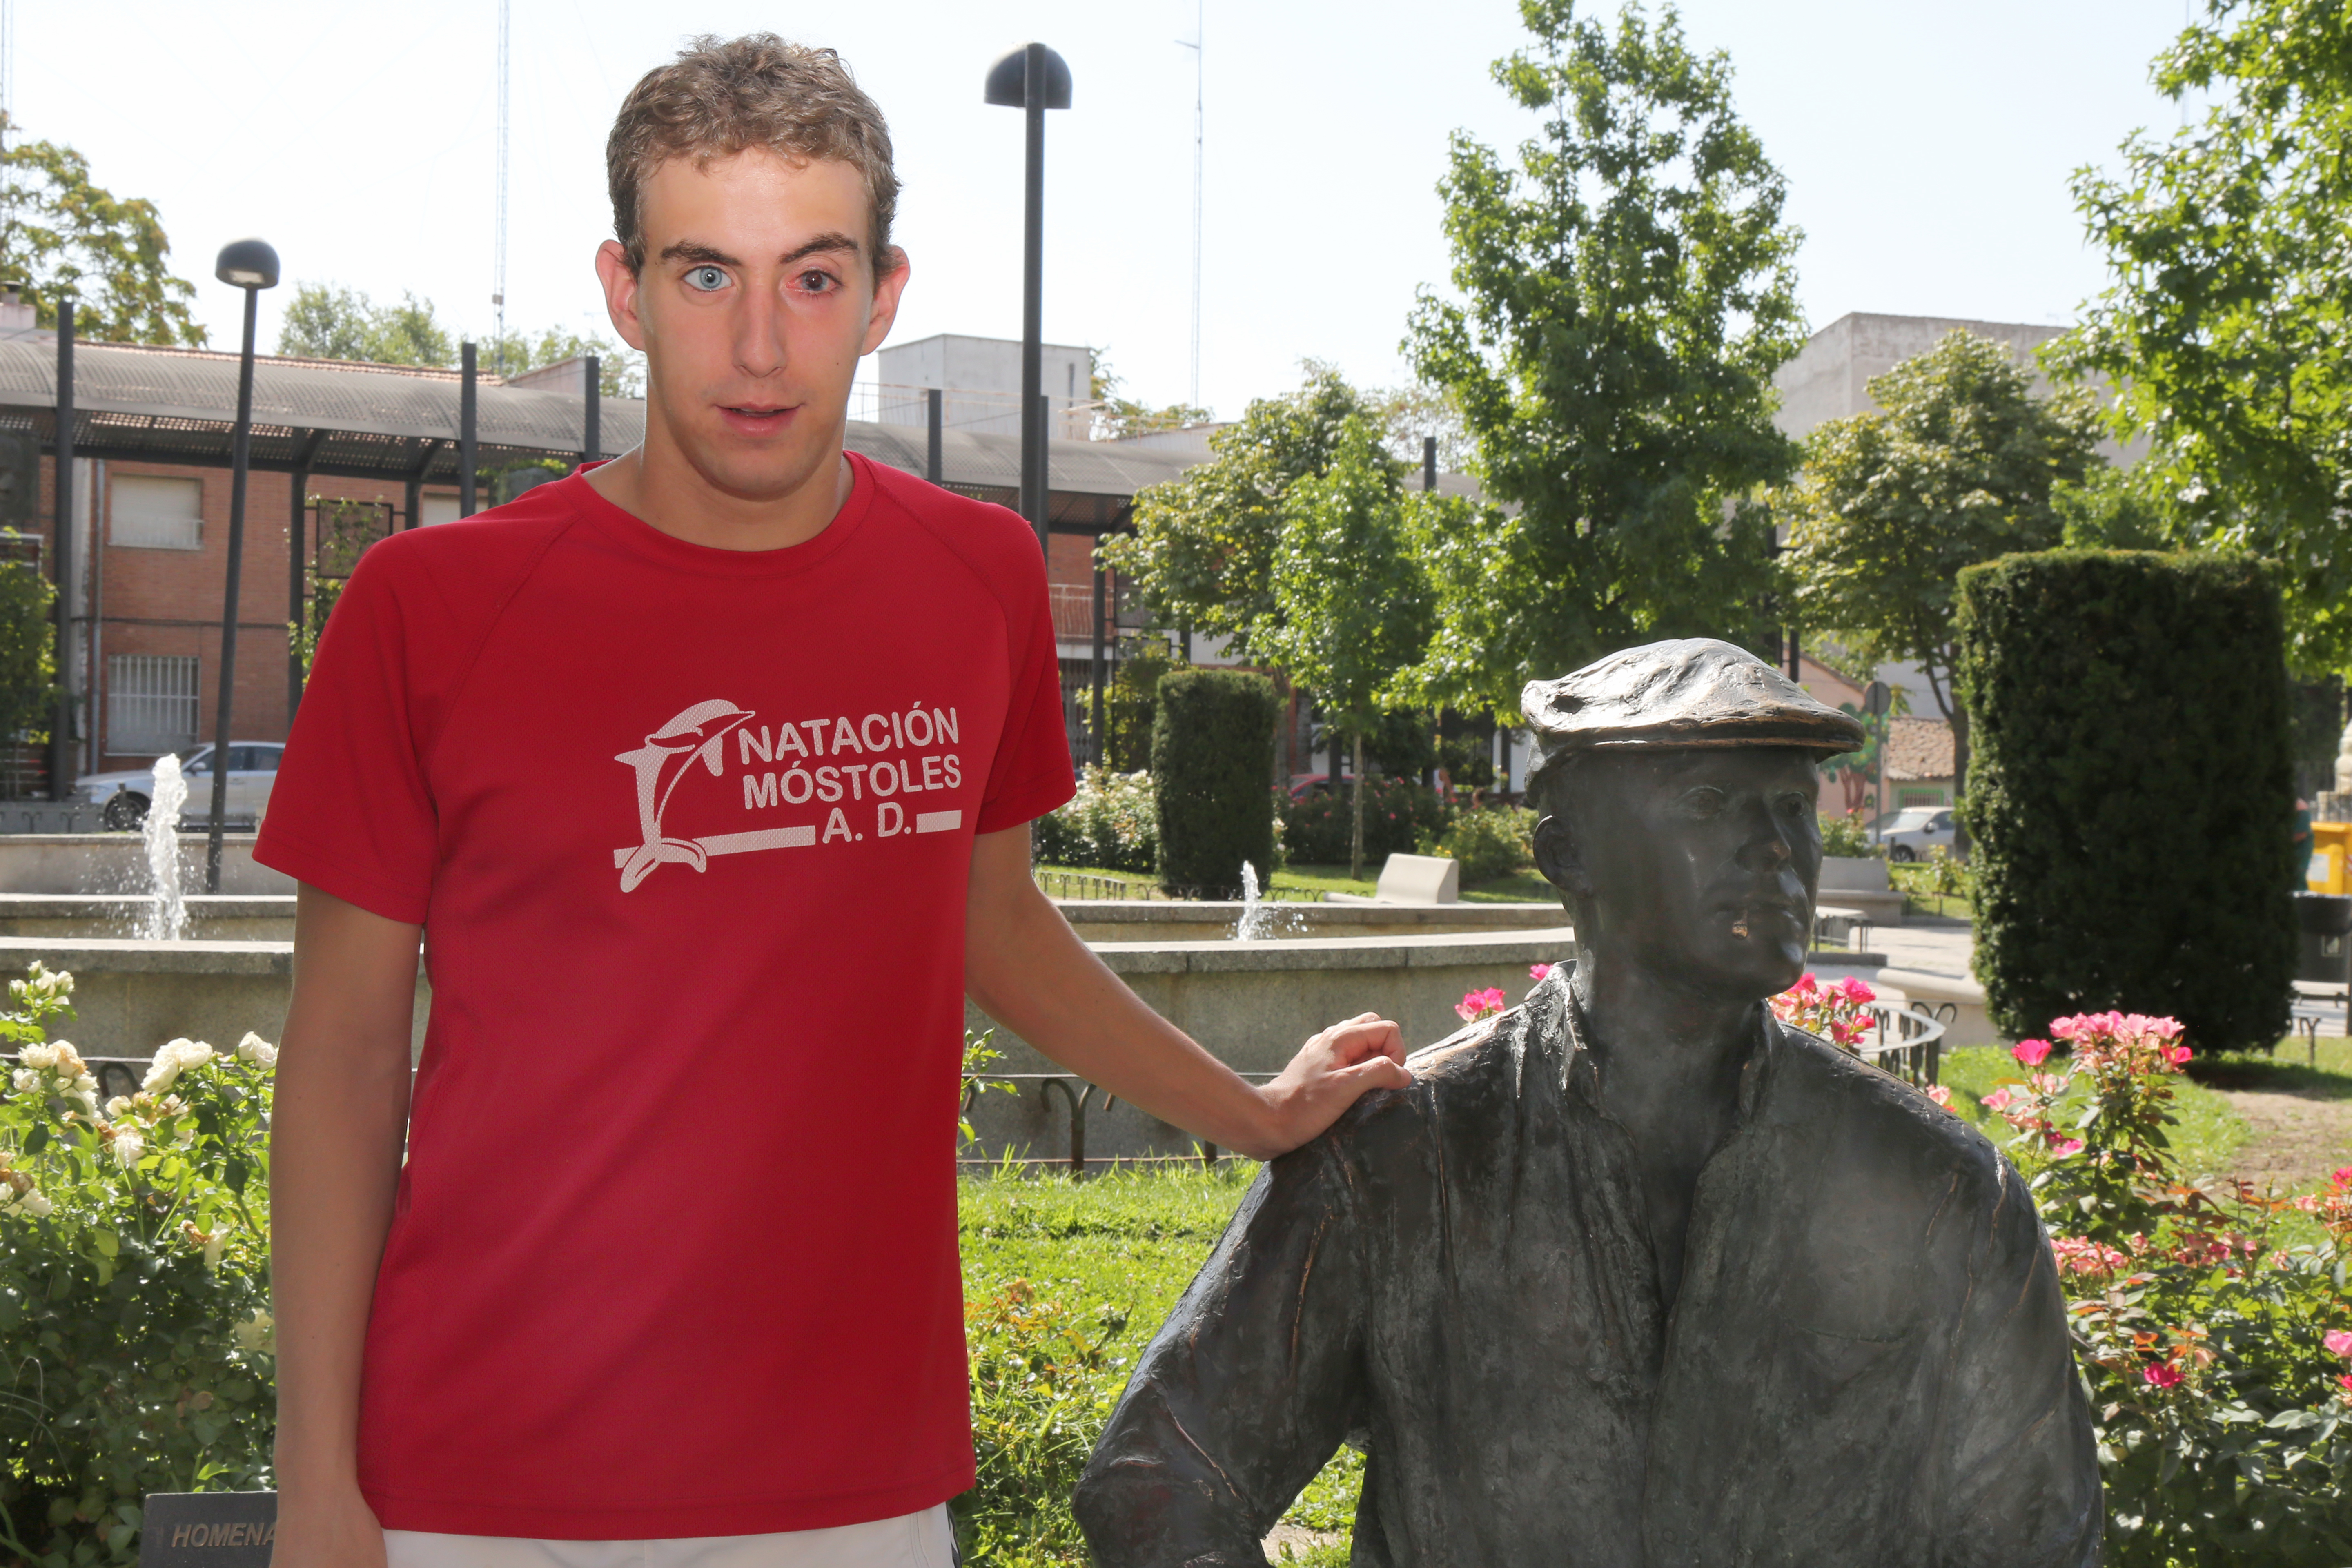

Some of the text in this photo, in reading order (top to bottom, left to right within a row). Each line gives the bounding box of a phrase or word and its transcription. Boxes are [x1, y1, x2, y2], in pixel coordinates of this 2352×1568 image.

[738, 701, 959, 765] NATACIÓN
[743, 754, 962, 810] MÓSTOLES
[822, 802, 911, 844] A. D.
